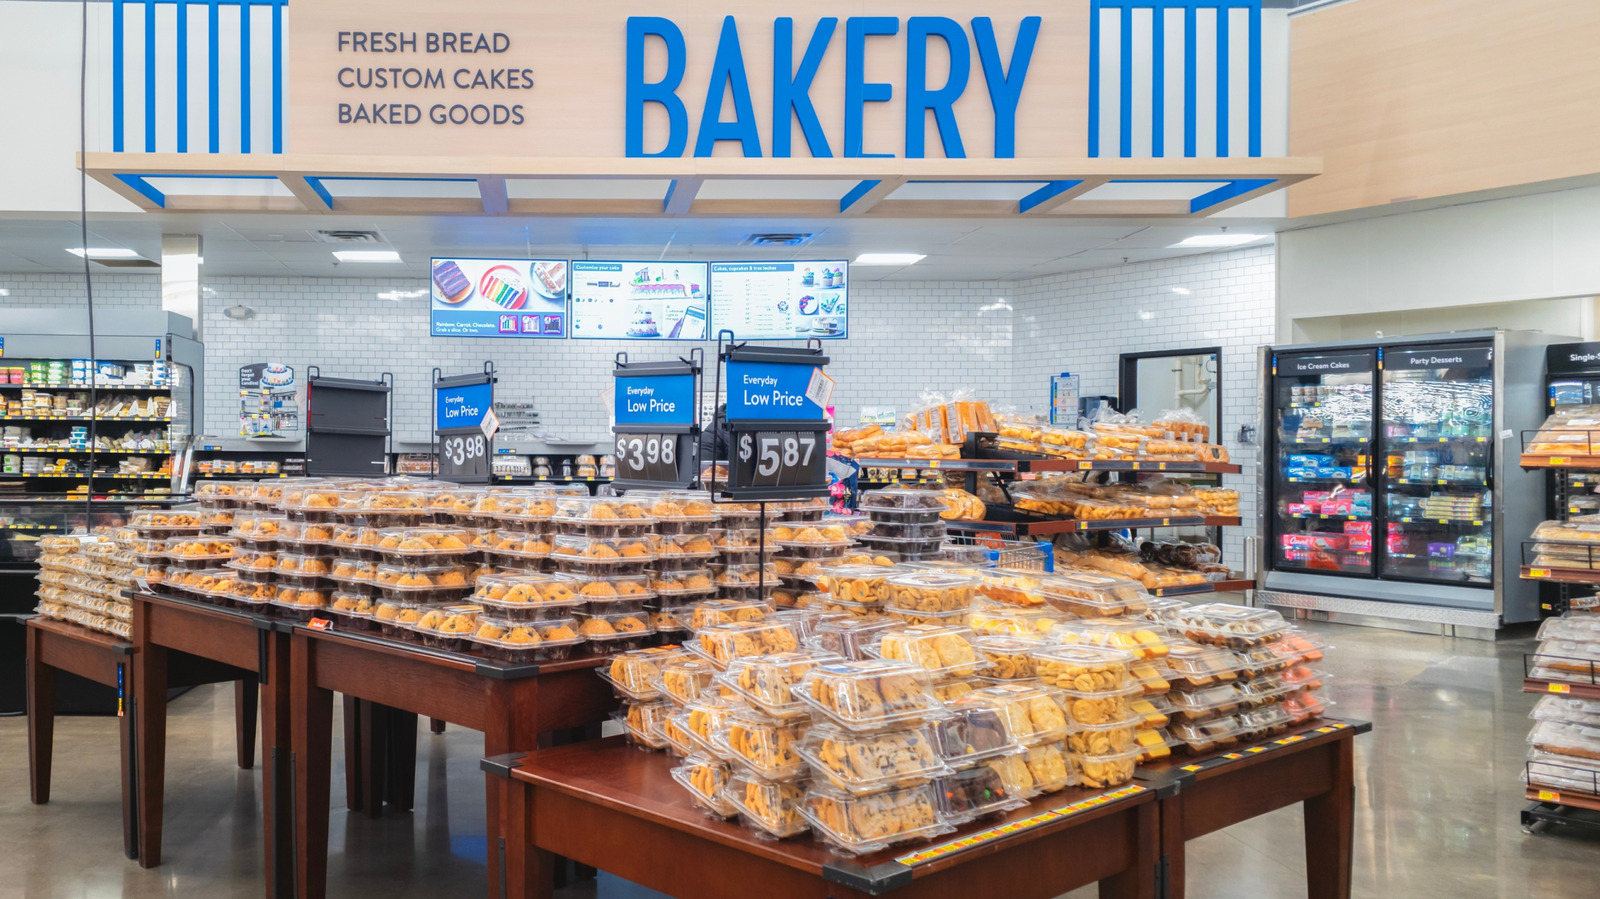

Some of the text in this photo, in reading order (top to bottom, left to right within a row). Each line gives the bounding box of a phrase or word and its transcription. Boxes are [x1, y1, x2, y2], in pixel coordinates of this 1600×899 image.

[338, 32, 510, 54] FRESH BREAD
[338, 67, 534, 89] CUSTOM CAKES
[624, 15, 1042, 158] BAKERY
[338, 103, 525, 125] BAKED GOODS
[1431, 356, 1462, 364] Desserts
[743, 374, 778, 387] Everyday
[627, 386, 654, 397] Everyday
[744, 390, 803, 406] Low Price
[445, 396, 464, 405] Everyday
[627, 400, 675, 412] Low Price
[446, 407, 460, 418] Low
[461, 405, 479, 417] Price
